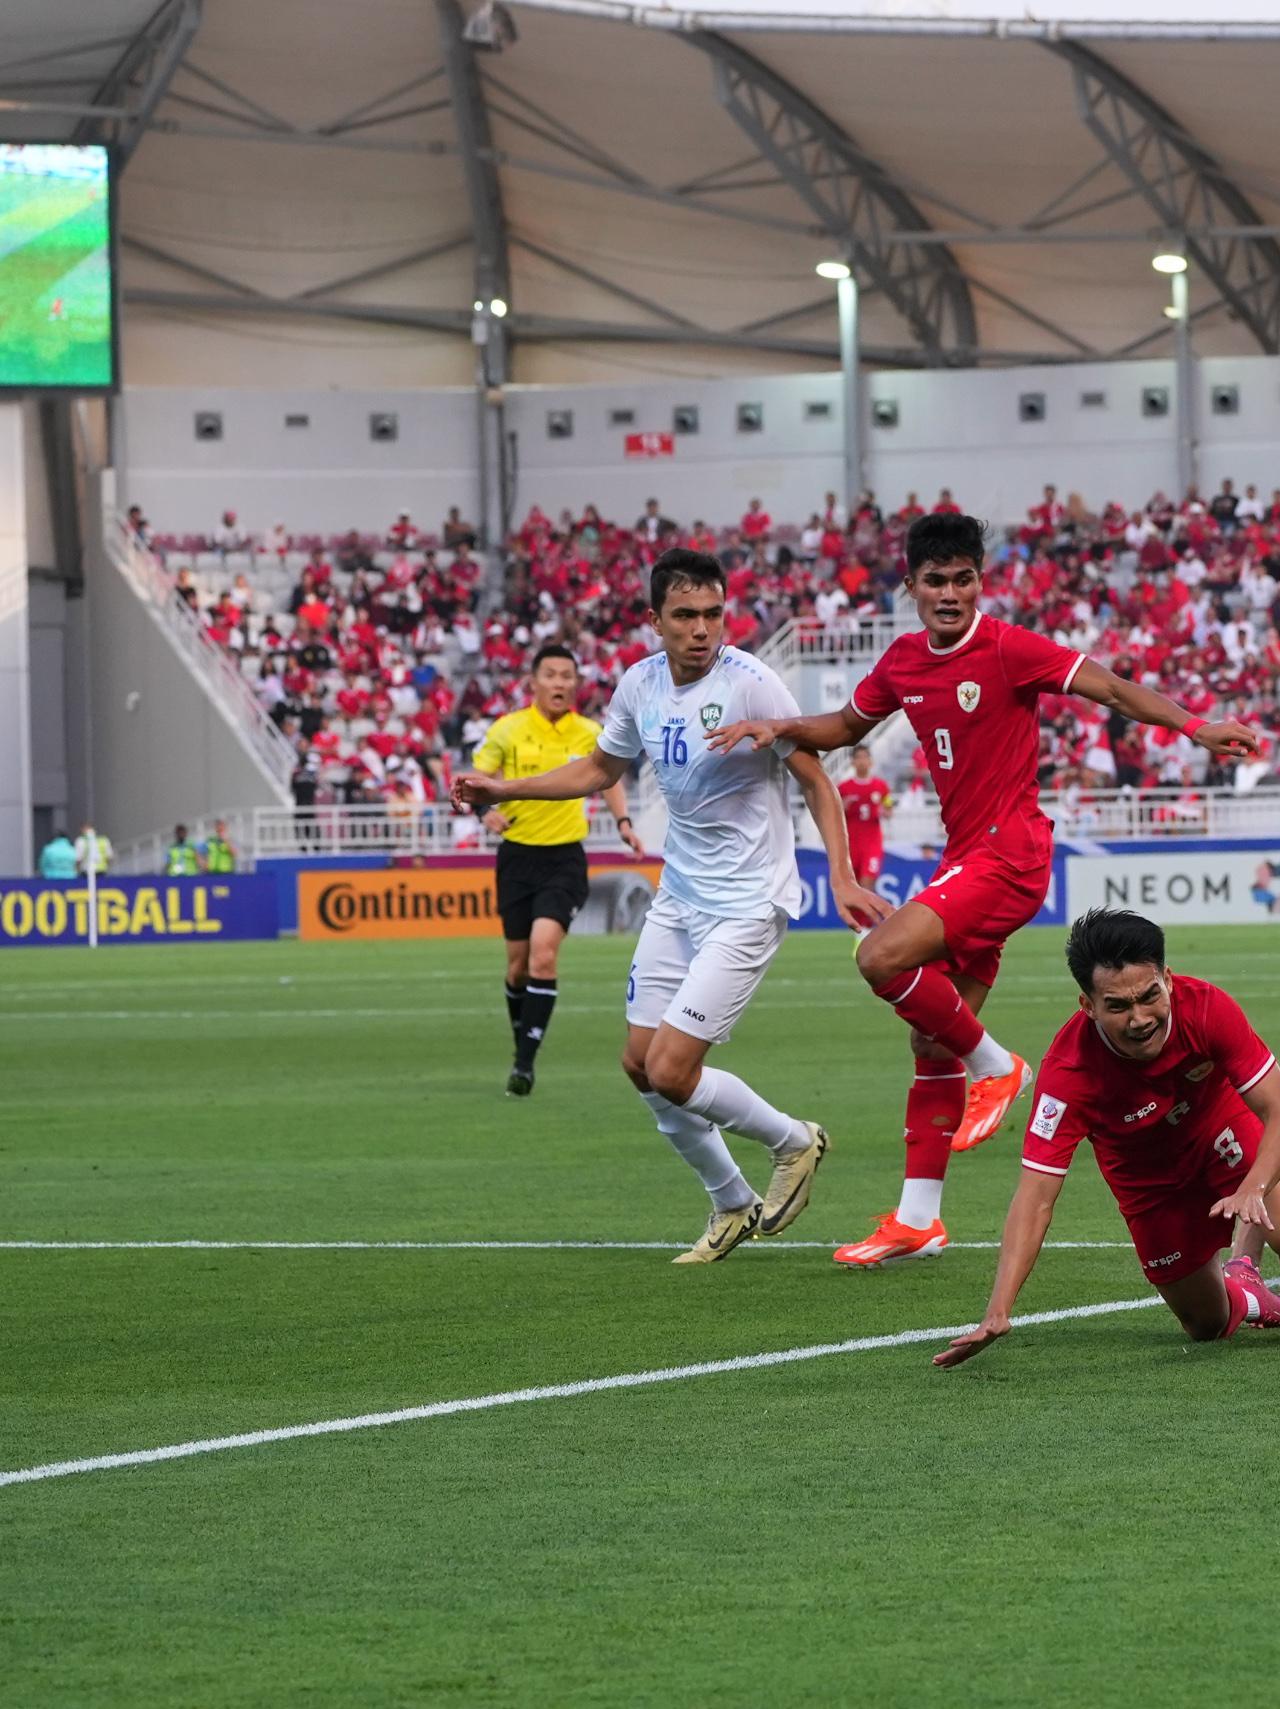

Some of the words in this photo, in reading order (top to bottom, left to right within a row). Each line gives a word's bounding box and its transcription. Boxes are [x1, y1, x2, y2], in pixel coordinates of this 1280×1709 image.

[667, 717, 685, 726] JAKO
[702, 707, 720, 720] UFA
[662, 725, 689, 768] 16
[934, 728, 954, 770] 9
[1105, 873, 1231, 904] NEOM
[0, 887, 222, 937] OOTBALL
[317, 882, 499, 931] Continent
[682, 1006, 706, 1022] JAKO
[1124, 1101, 1157, 1124] erspo
[1213, 1126, 1243, 1169] 8
[1148, 1251, 1182, 1268] erspo
